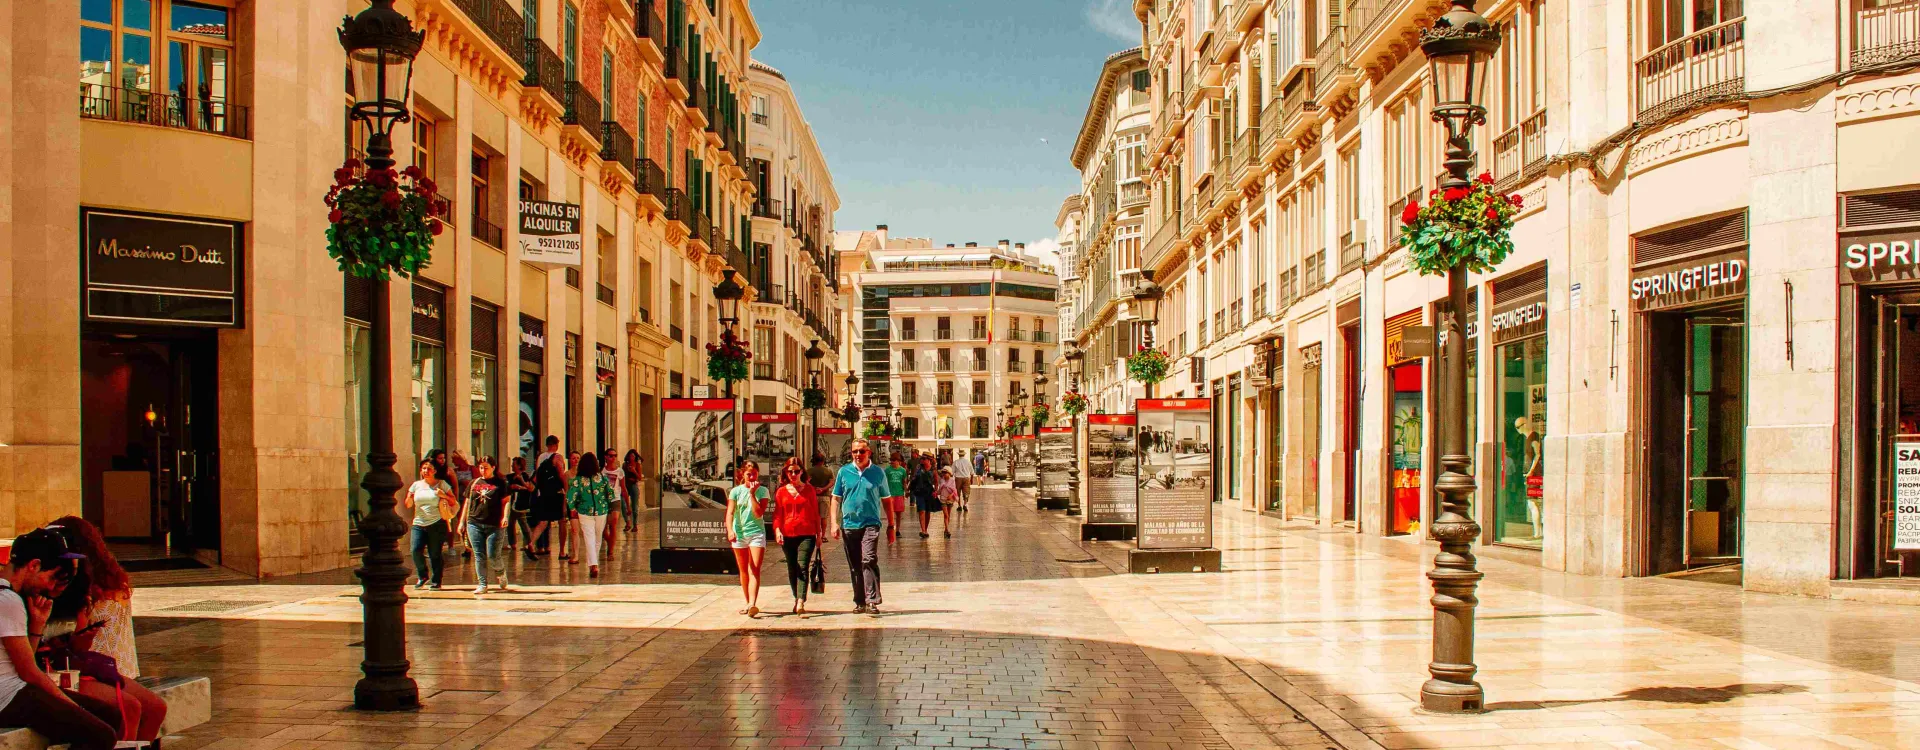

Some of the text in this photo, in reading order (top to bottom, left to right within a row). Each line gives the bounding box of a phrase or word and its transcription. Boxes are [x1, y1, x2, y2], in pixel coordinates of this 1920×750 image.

[519, 201, 579, 219] OFICINAS EN
[524, 216, 572, 233] ALQUILER
[98, 239, 225, 265] Massimo Dutti
[538, 237, 580, 250] 952121205
[1845, 239, 1920, 269] SPRI
[1631, 260, 1742, 299] SPRINGFIELD
[1492, 302, 1543, 332] SPRINGFIELD
